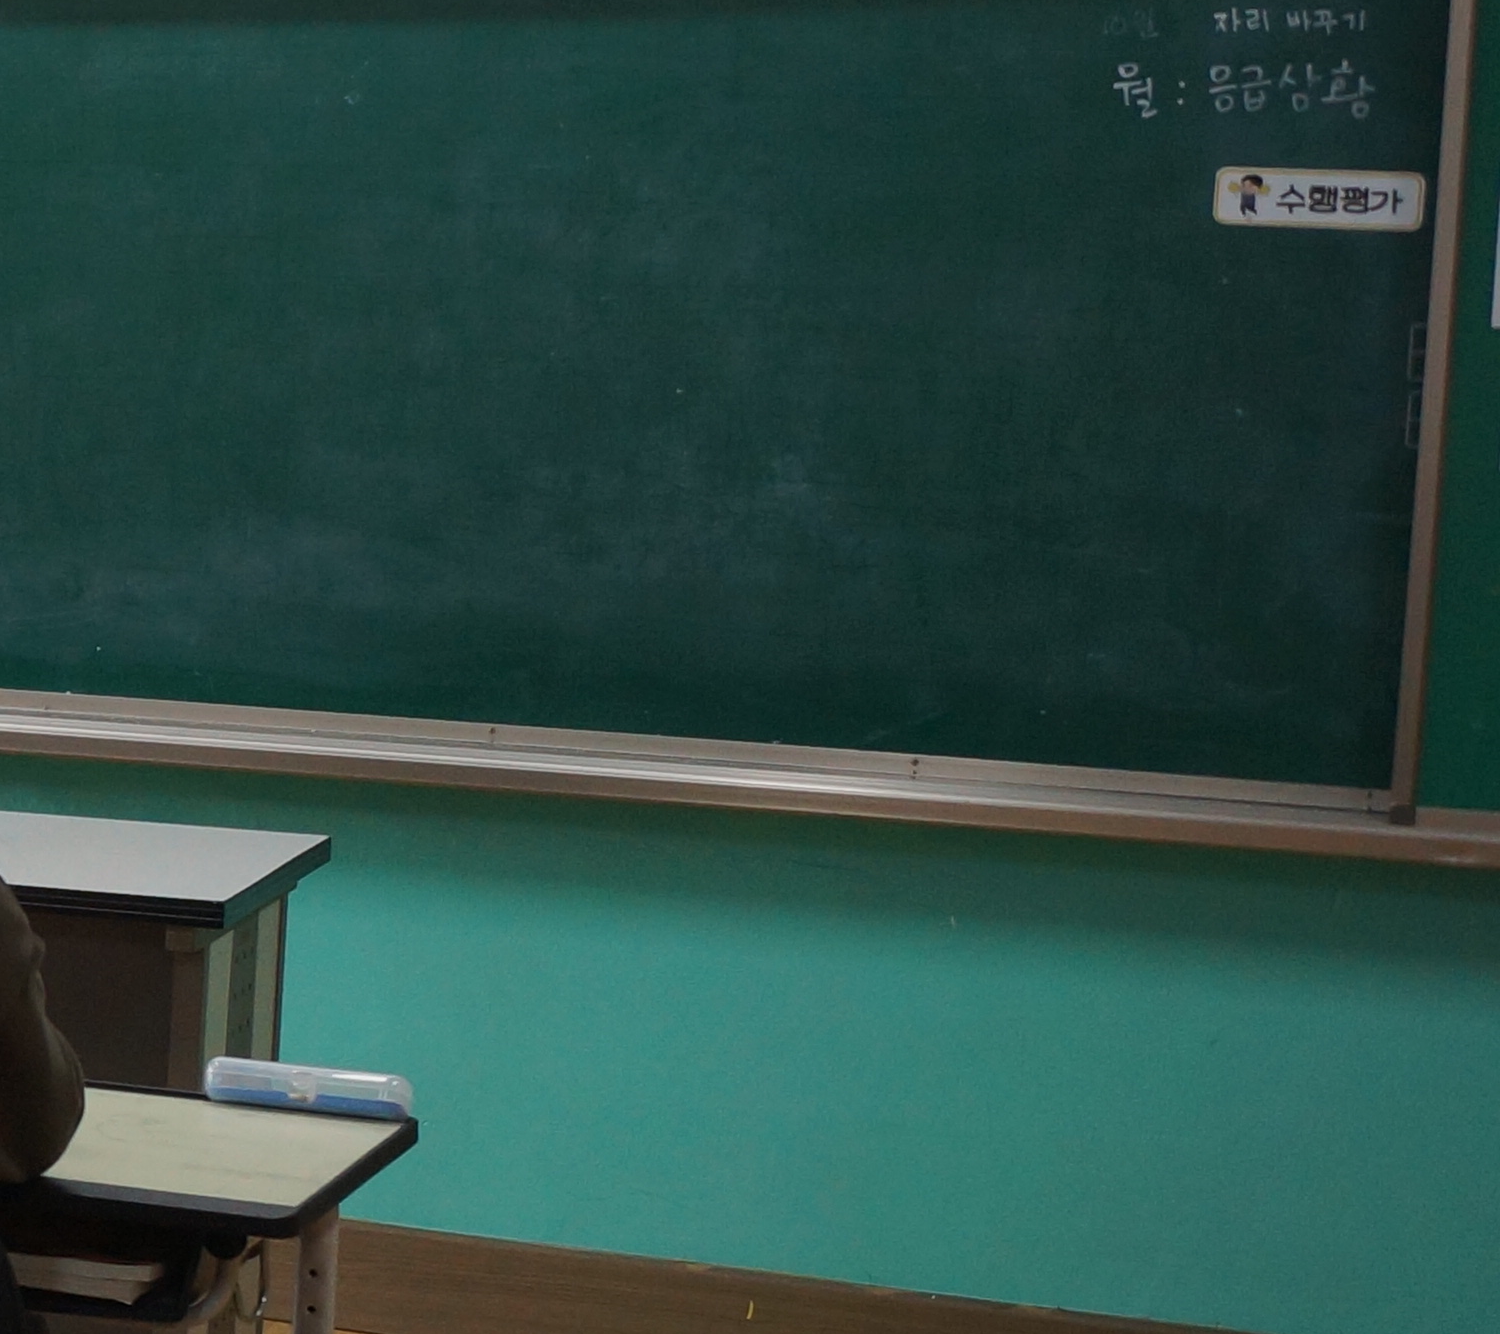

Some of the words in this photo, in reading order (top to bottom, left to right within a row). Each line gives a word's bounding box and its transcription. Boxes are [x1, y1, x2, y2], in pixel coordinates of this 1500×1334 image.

[1213, 6, 1270, 34] 자리
[1285, 8, 1367, 36] 바꾸기
[1208, 58, 1376, 120] 응급상황
[1276, 186, 1403, 215] 수행평가
